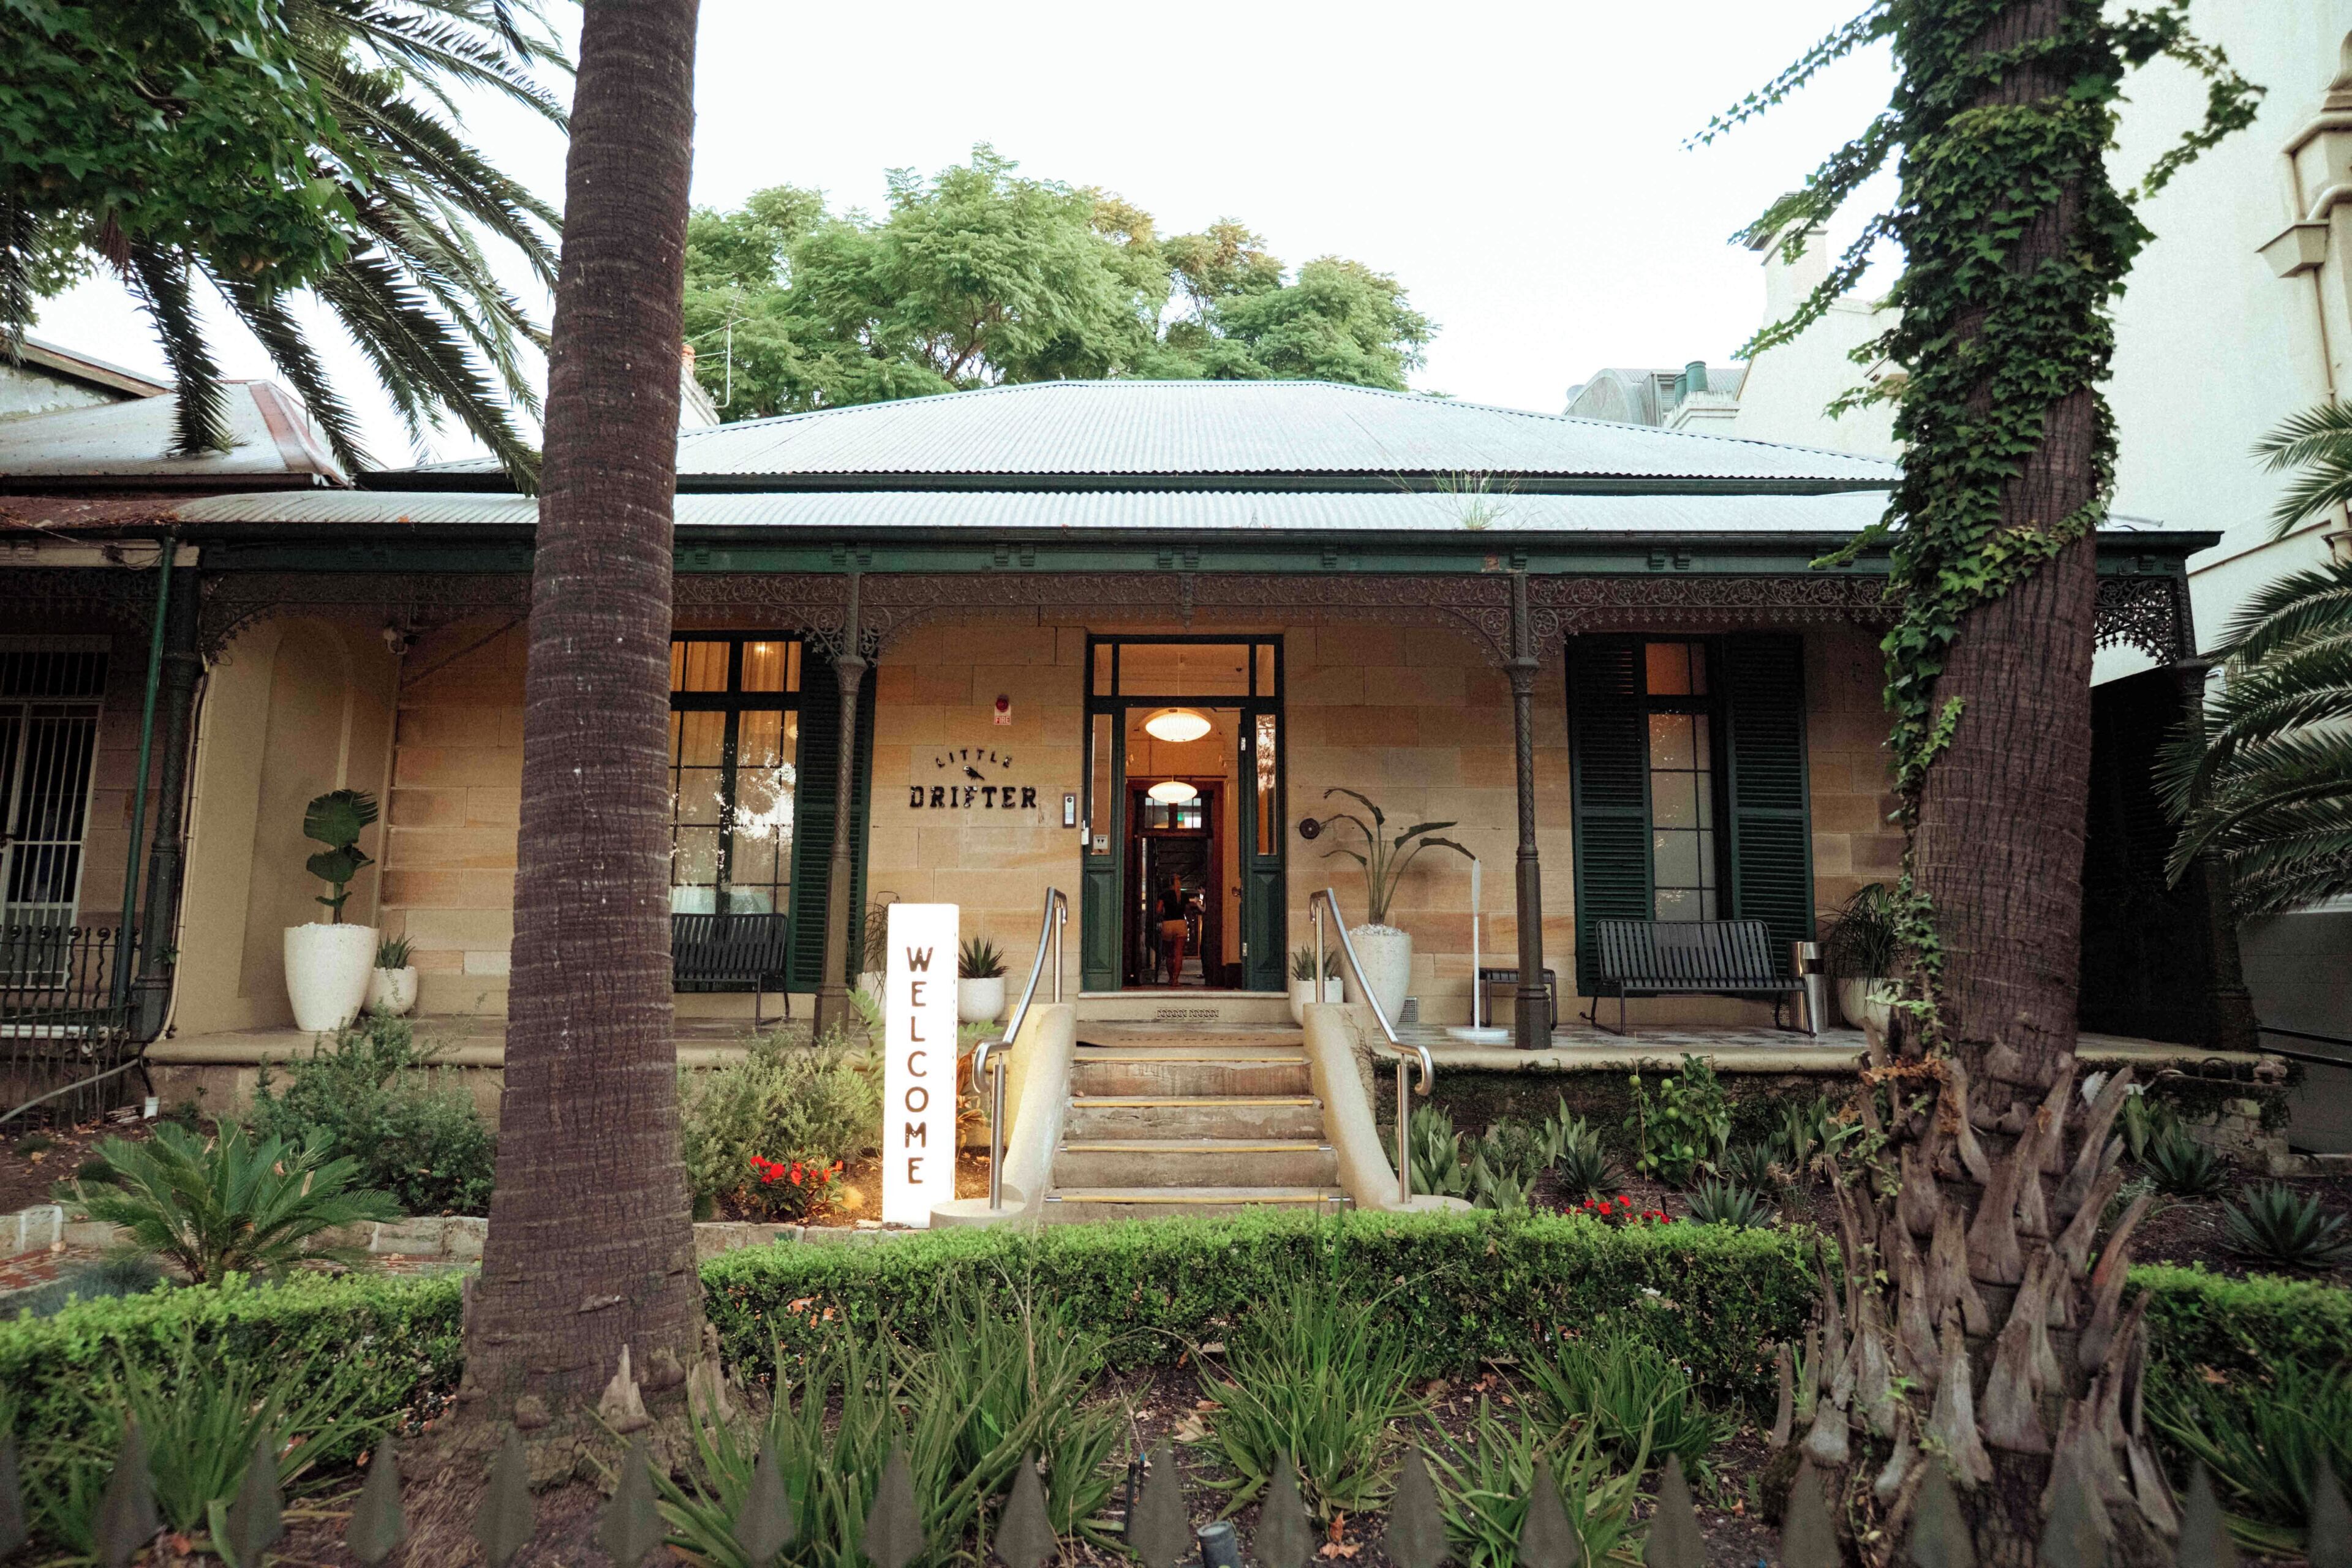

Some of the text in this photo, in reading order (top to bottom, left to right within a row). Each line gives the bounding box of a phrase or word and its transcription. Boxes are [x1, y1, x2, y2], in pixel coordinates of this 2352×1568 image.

[935, 748, 1012, 769] LITTLE
[909, 786, 1037, 809] DRIFTER
[905, 946, 933, 1185] WELCOME
